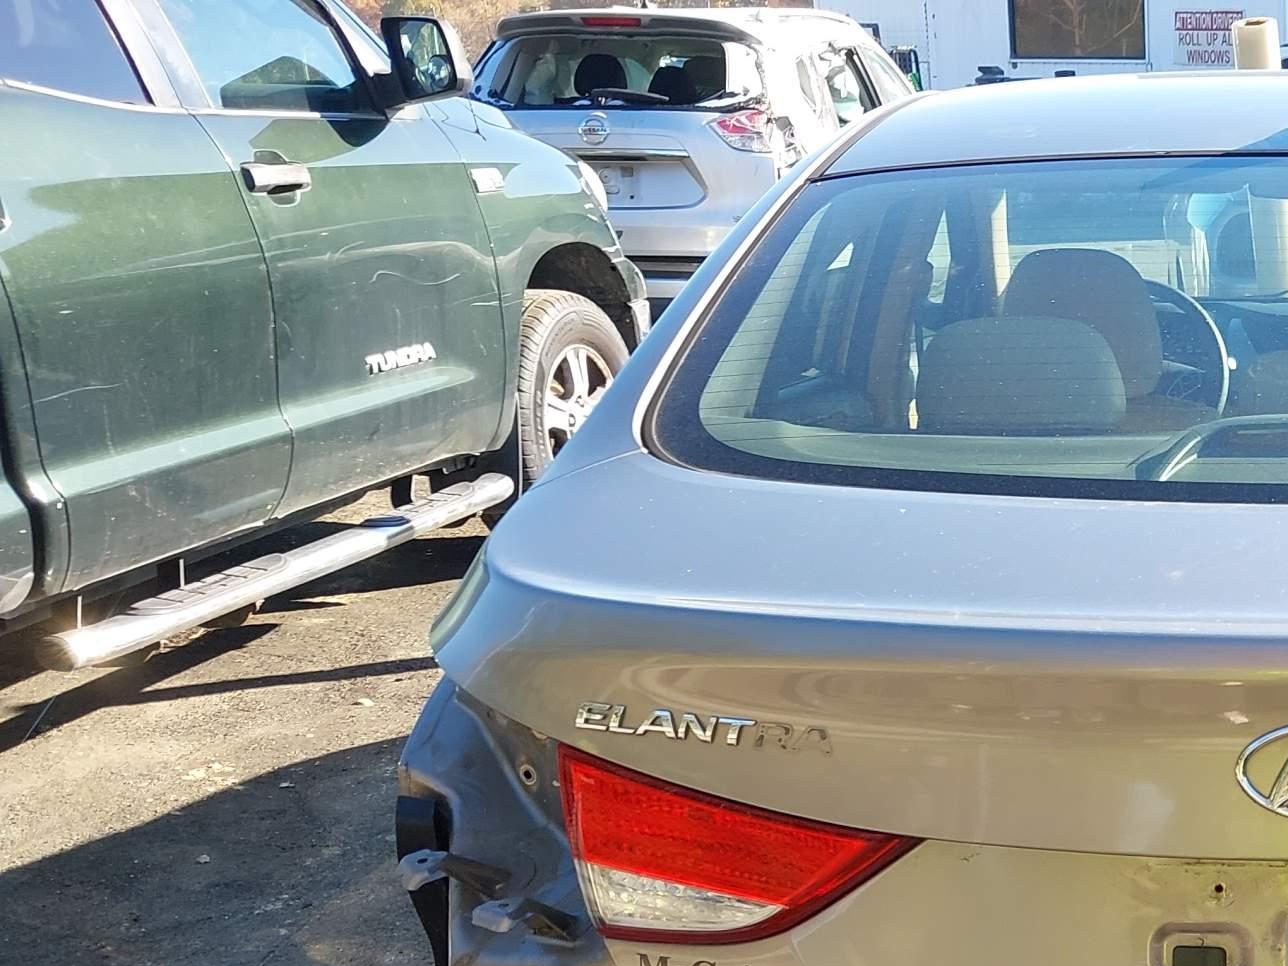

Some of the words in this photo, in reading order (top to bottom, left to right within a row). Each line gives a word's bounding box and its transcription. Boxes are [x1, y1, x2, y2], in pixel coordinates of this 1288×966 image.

[1177, 13, 1212, 29] ATTENTION
[1178, 31, 1202, 46] ROLL
[1206, 31, 1219, 46] UP
[1221, 31, 1234, 46] AL
[1186, 50, 1231, 64] WINDOWS
[365, 341, 437, 375] TUNDRA
